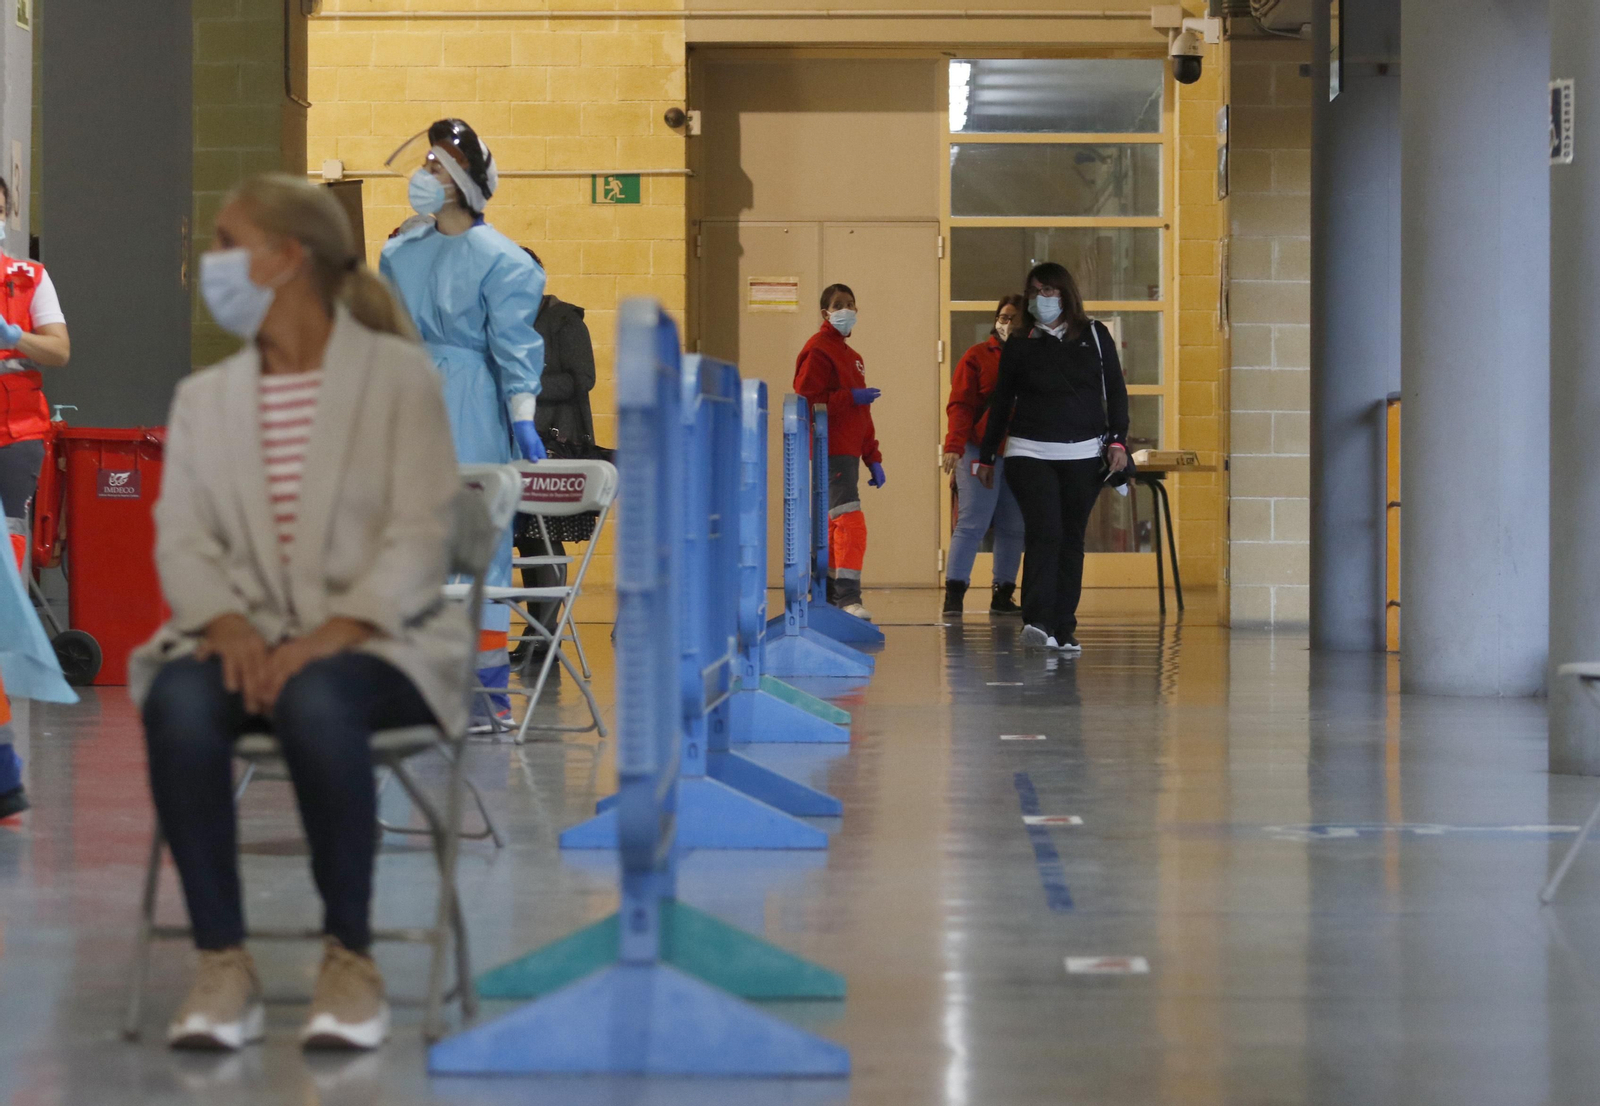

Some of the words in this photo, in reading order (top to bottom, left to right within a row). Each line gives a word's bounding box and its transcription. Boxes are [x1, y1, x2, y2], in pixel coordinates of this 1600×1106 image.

[1563, 85, 1571, 157] RESERVADO
[104, 486, 135, 494] IMDECO
[532, 477, 585, 491] IMDECO
